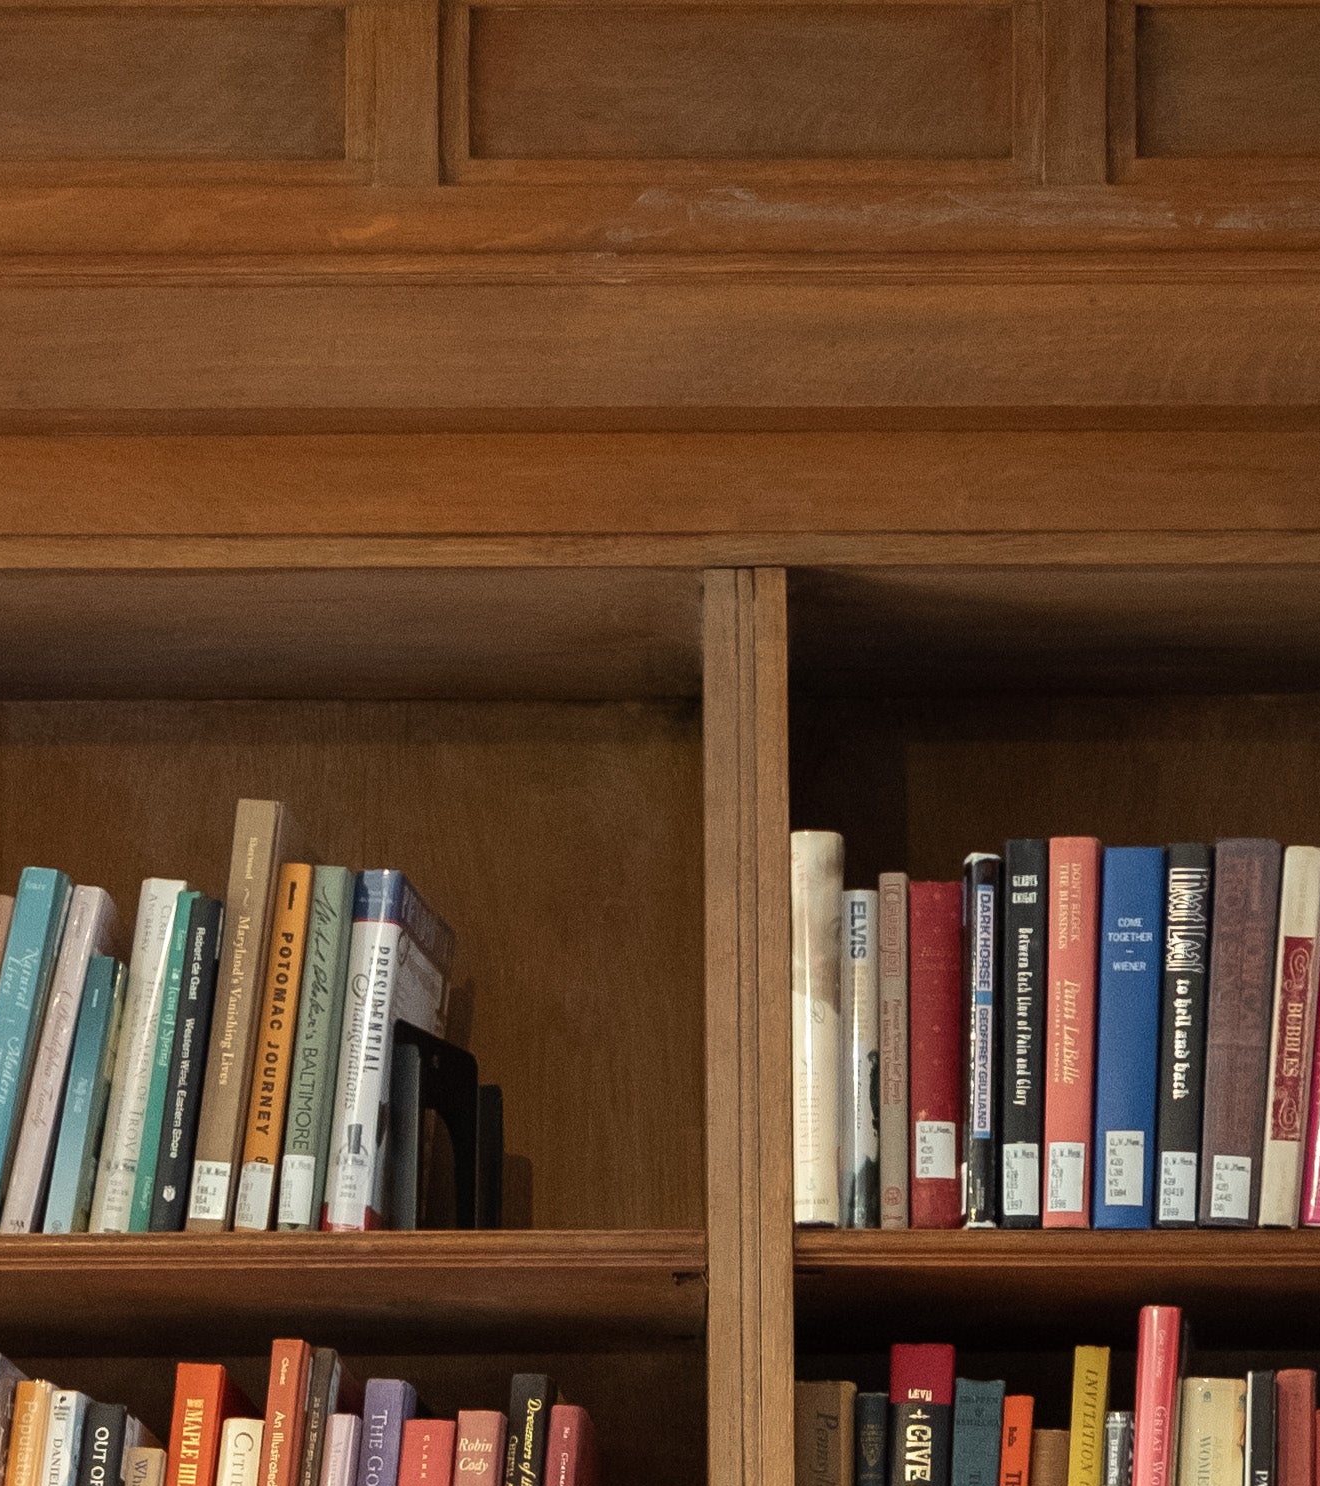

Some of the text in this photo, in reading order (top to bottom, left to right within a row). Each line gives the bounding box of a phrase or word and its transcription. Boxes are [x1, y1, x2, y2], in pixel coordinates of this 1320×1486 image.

[850, 901, 866, 959] ELVIS
[978, 893, 992, 989] DARK HORSE
[255, 931, 294, 1136] POTOMAC JOURNEY
[1061, 980, 1081, 1085] Patti LaBelle
[1283, 1002, 1304, 1077] BUBBLES
[92, 1427, 109, 1462] OUT
[179, 1409, 203, 1458] MAPLE
[368, 1410, 387, 1449] THE
[905, 1424, 932, 1482] GIVE
